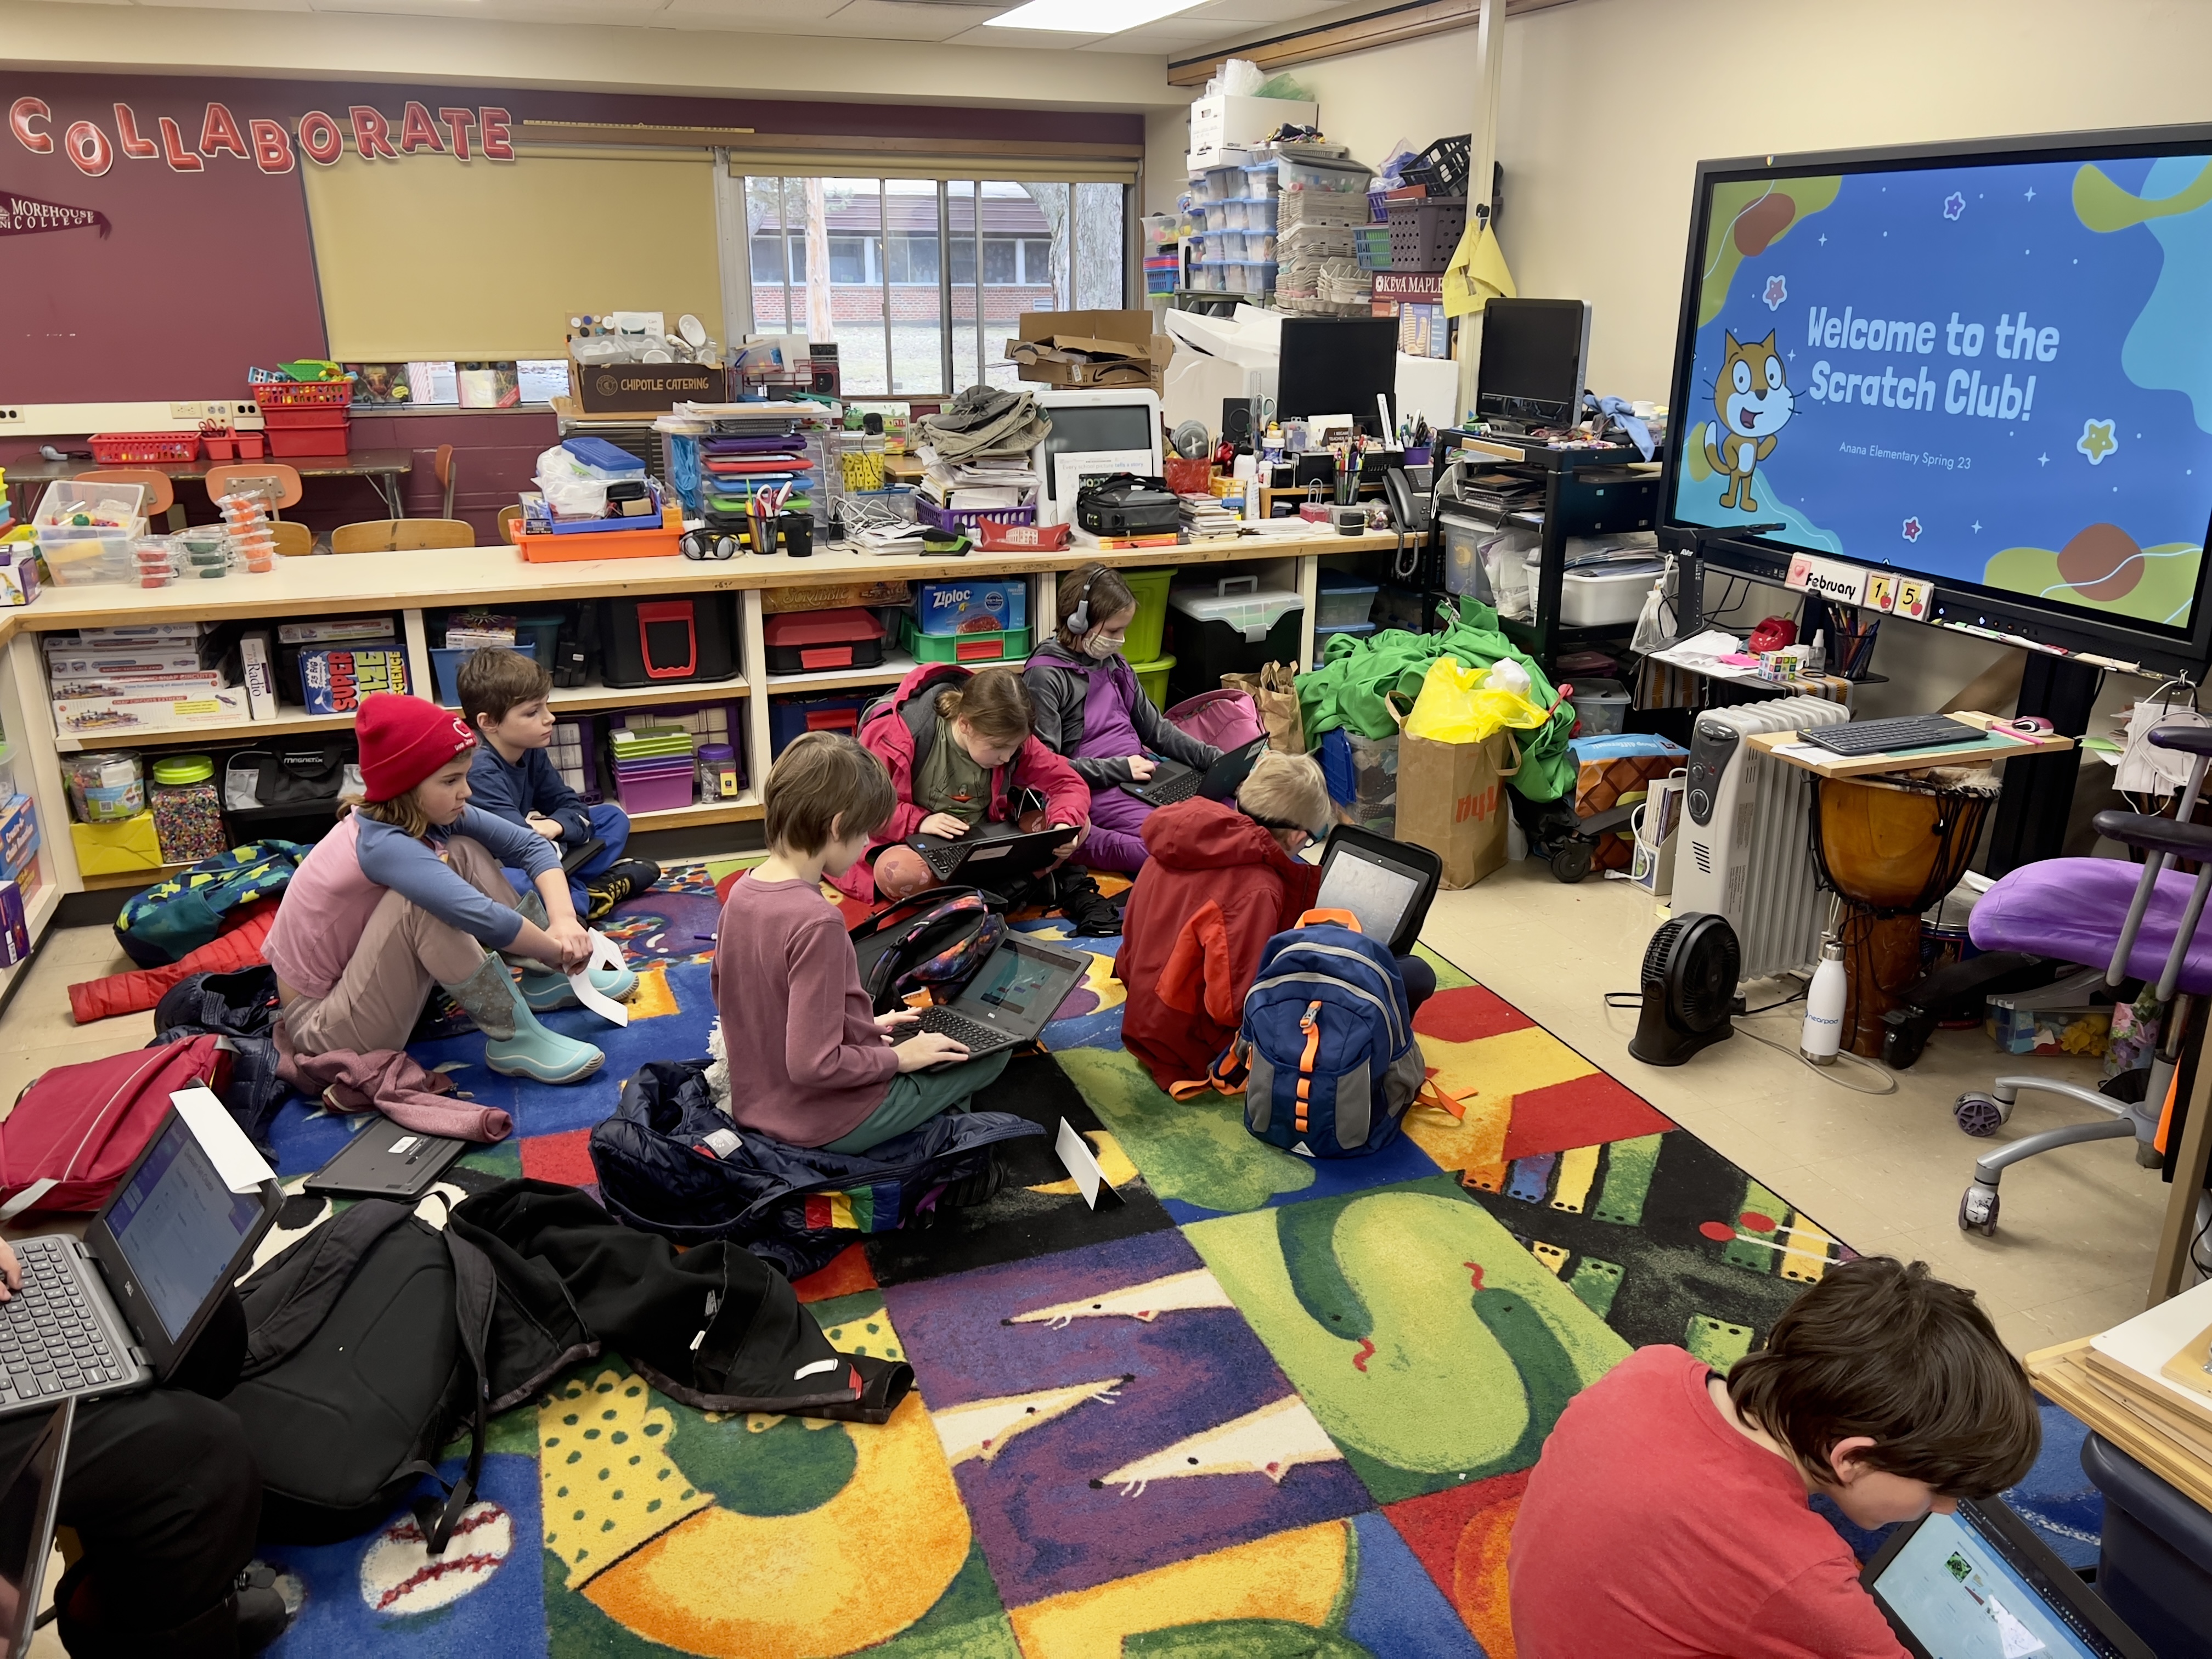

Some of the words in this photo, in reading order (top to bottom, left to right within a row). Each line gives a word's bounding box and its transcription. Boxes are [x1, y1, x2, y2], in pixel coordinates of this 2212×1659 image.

[9, 97, 515, 176] COLLABORATE
[11, 198, 93, 218] MOREHOUSE
[14, 216, 94, 229] COLLEGE
[1408, 276, 1443, 293] MAPLE
[1808, 306, 1936, 354] Welcome
[1946, 312, 1984, 357] to
[1995, 312, 2059, 362] the
[620, 379, 663, 391] CHIPOTLE
[666, 377, 709, 390] CATERING
[1809, 360, 1936, 411] Scratch
[1945, 369, 2036, 421] Club!
[1839, 442, 1866, 455] Anana
[1870, 445, 1920, 465] Elementary
[1922, 452, 1954, 470] Spring
[1957, 457, 1971, 469] 23
[933, 589, 970, 608] Ziploc
[1806, 573, 1856, 600] February
[1875, 582, 1882, 597] 1
[1903, 588, 1915, 605] 5
[310, 661, 318, 673] BIG
[389, 651, 404, 696] SCIENCE
[247, 663, 263, 697] Radio
[311, 675, 319, 684] 25
[327, 651, 356, 711] SUPER
[1809, 1014, 1838, 1024] nearpod
